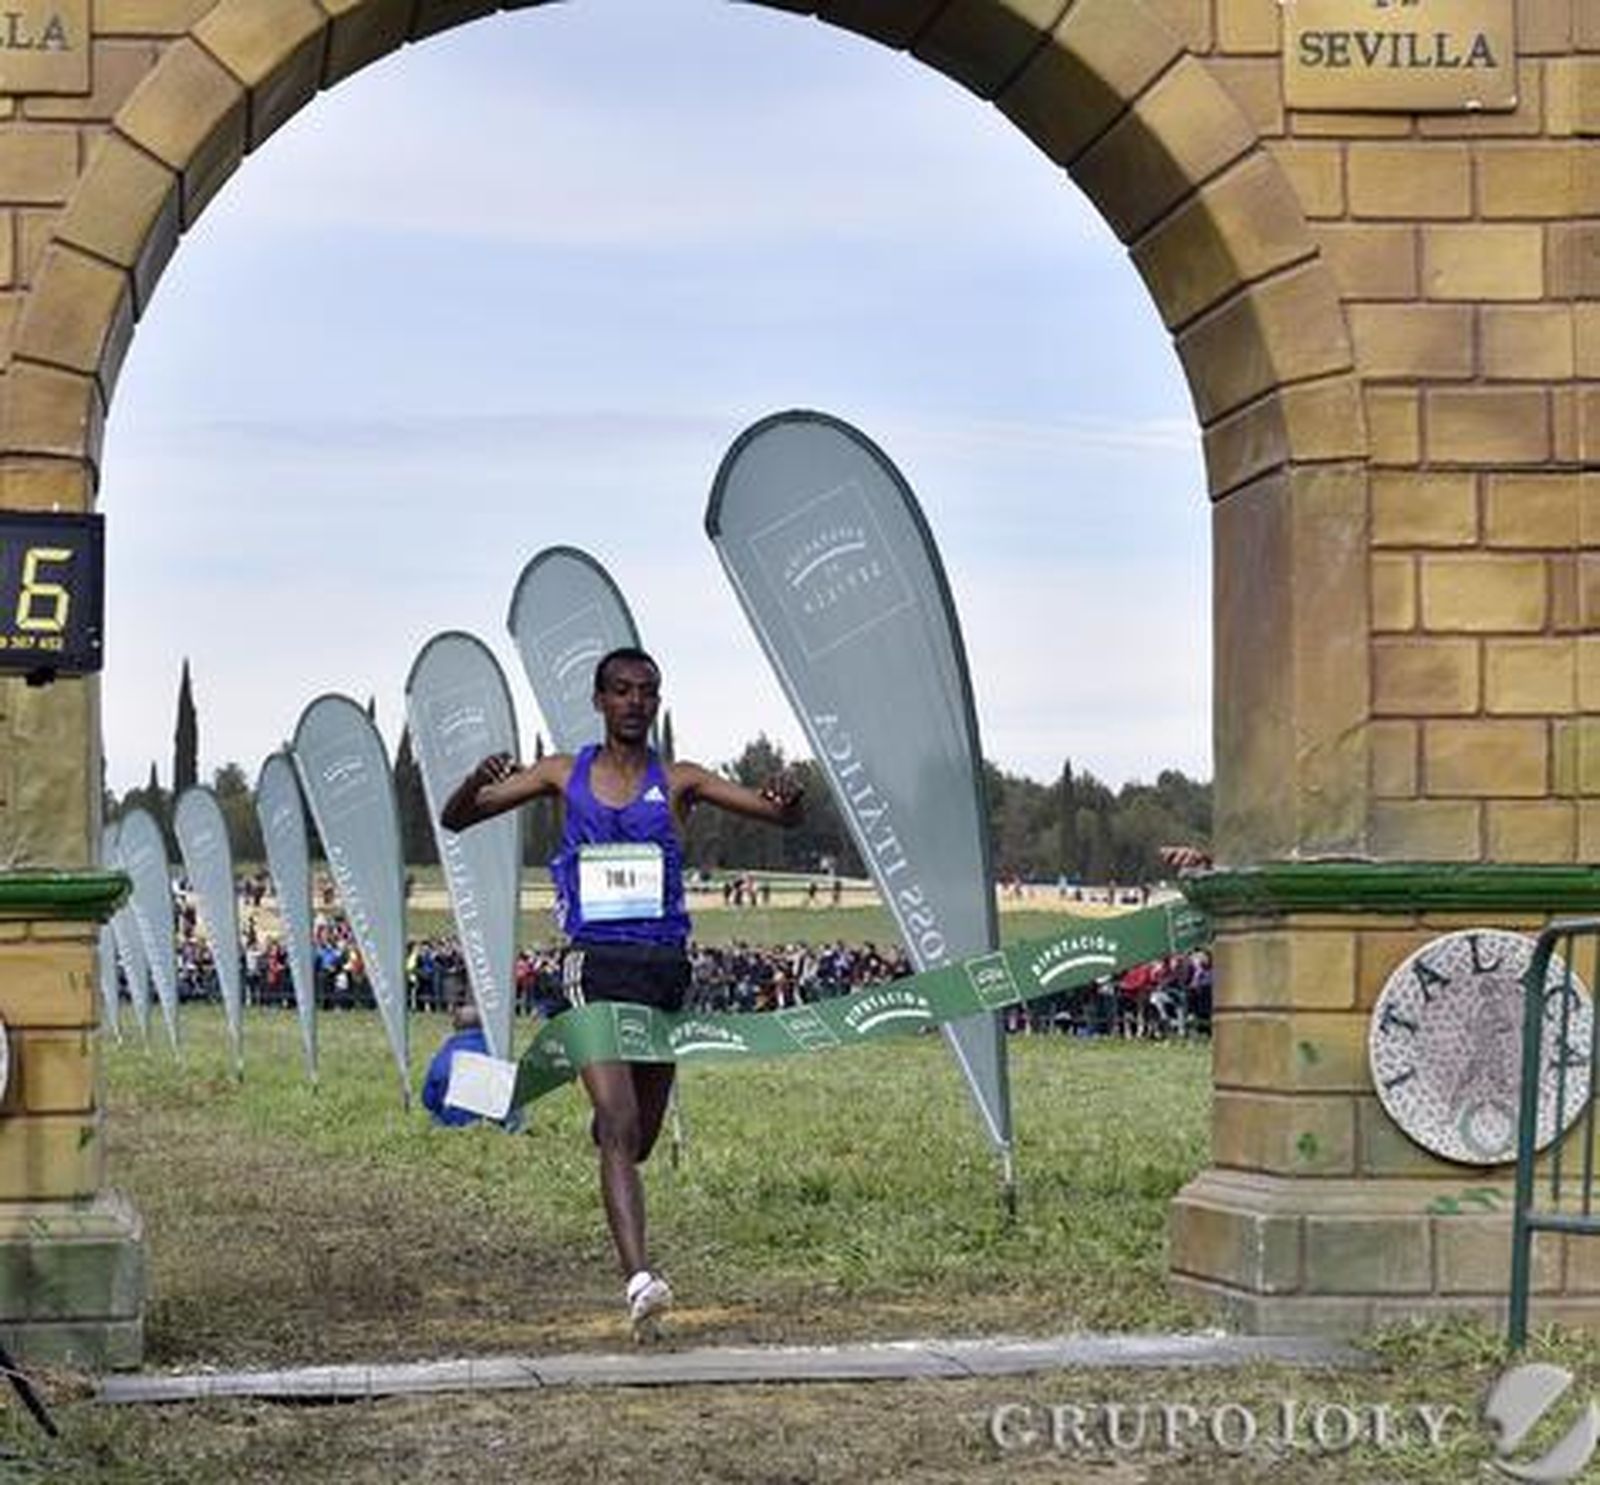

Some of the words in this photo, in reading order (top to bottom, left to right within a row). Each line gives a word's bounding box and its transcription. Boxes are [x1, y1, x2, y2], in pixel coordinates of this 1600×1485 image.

[0, 12, 72, 51] LA
[1299, 31, 1497, 68] SEVILLA
[16, 547, 74, 631] 6
